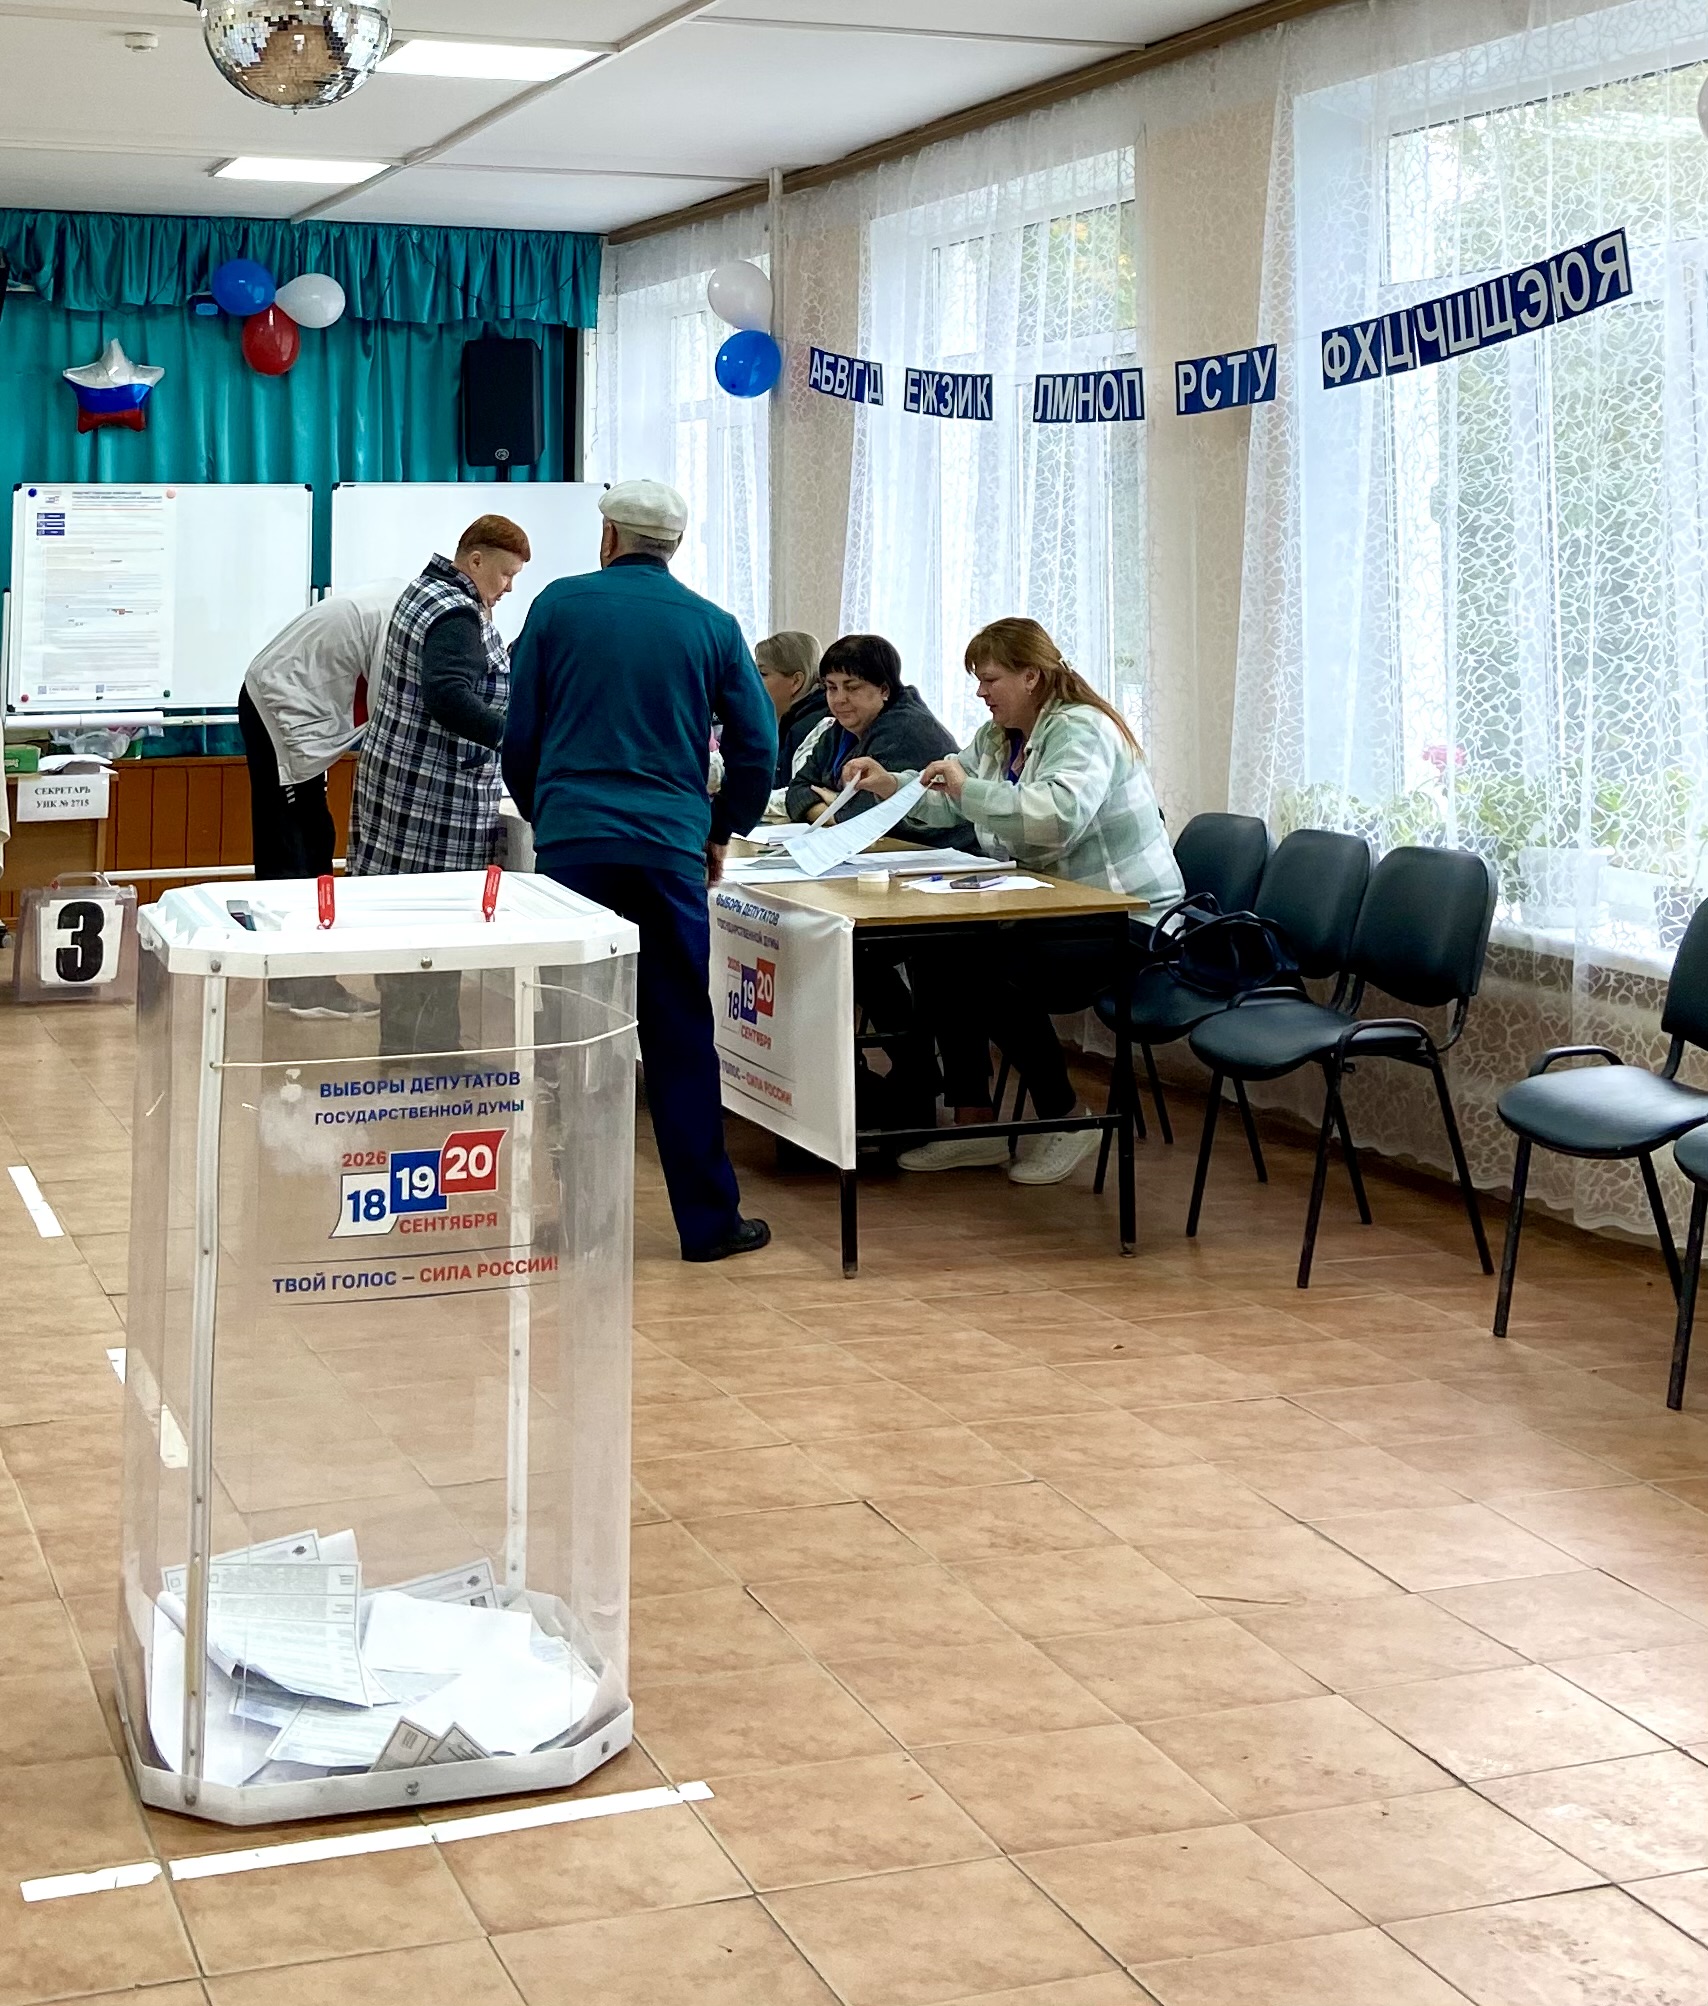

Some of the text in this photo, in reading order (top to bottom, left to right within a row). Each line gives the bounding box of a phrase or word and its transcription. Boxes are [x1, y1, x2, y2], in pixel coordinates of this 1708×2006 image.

[809, 232, 1630, 421] АБВГД ЕЖЗИК ЛМНОП РСТУ ФХЦЧШЩЭЮЯ
[34, 786, 91, 796] СЕКРЕТАРЬ
[36, 800, 57, 809] УИК
[70, 798, 90, 808] 2715
[741, 903, 780, 926] ДЕПУТАТОВ
[56, 901, 105, 982] 3
[728, 969, 773, 1021] 18 19 20
[319, 1071, 521, 1098] ВЫБОРЫ ДЕПУТАТОВ
[314, 1099, 525, 1125] ГОСУДАРСТВЕННОЙ ДУМЫ
[342, 1151, 387, 1168] 2026
[346, 1144, 494, 1223] 18 19 20
[399, 1211, 498, 1235] СЕНТЯБРЯ
[272, 1272, 326, 1294] ТВОЙ
[331, 1270, 397, 1291] ГОЛОС
[419, 1264, 472, 1284] СИЛА
[477, 1256, 559, 1279] РОССИИ!
